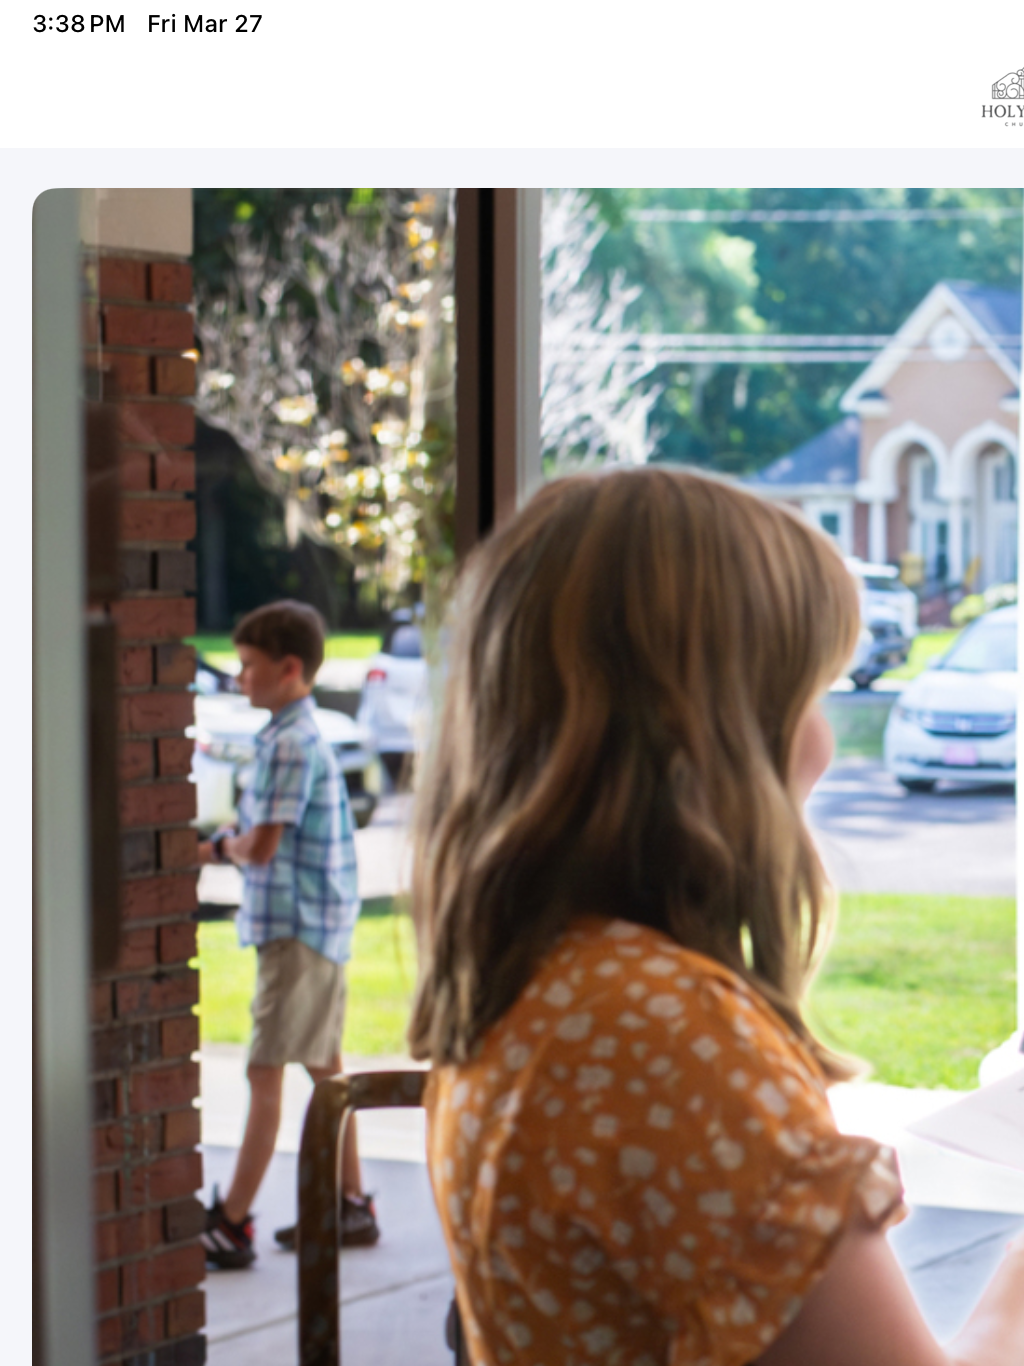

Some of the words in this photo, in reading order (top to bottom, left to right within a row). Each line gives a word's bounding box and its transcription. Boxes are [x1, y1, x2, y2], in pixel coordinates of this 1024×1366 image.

[33, 14, 86, 34] 3:38
[90, 14, 125, 33] PM
[148, 13, 176, 33] Fri
[184, 14, 228, 33] Mar
[235, 14, 263, 33] 27
